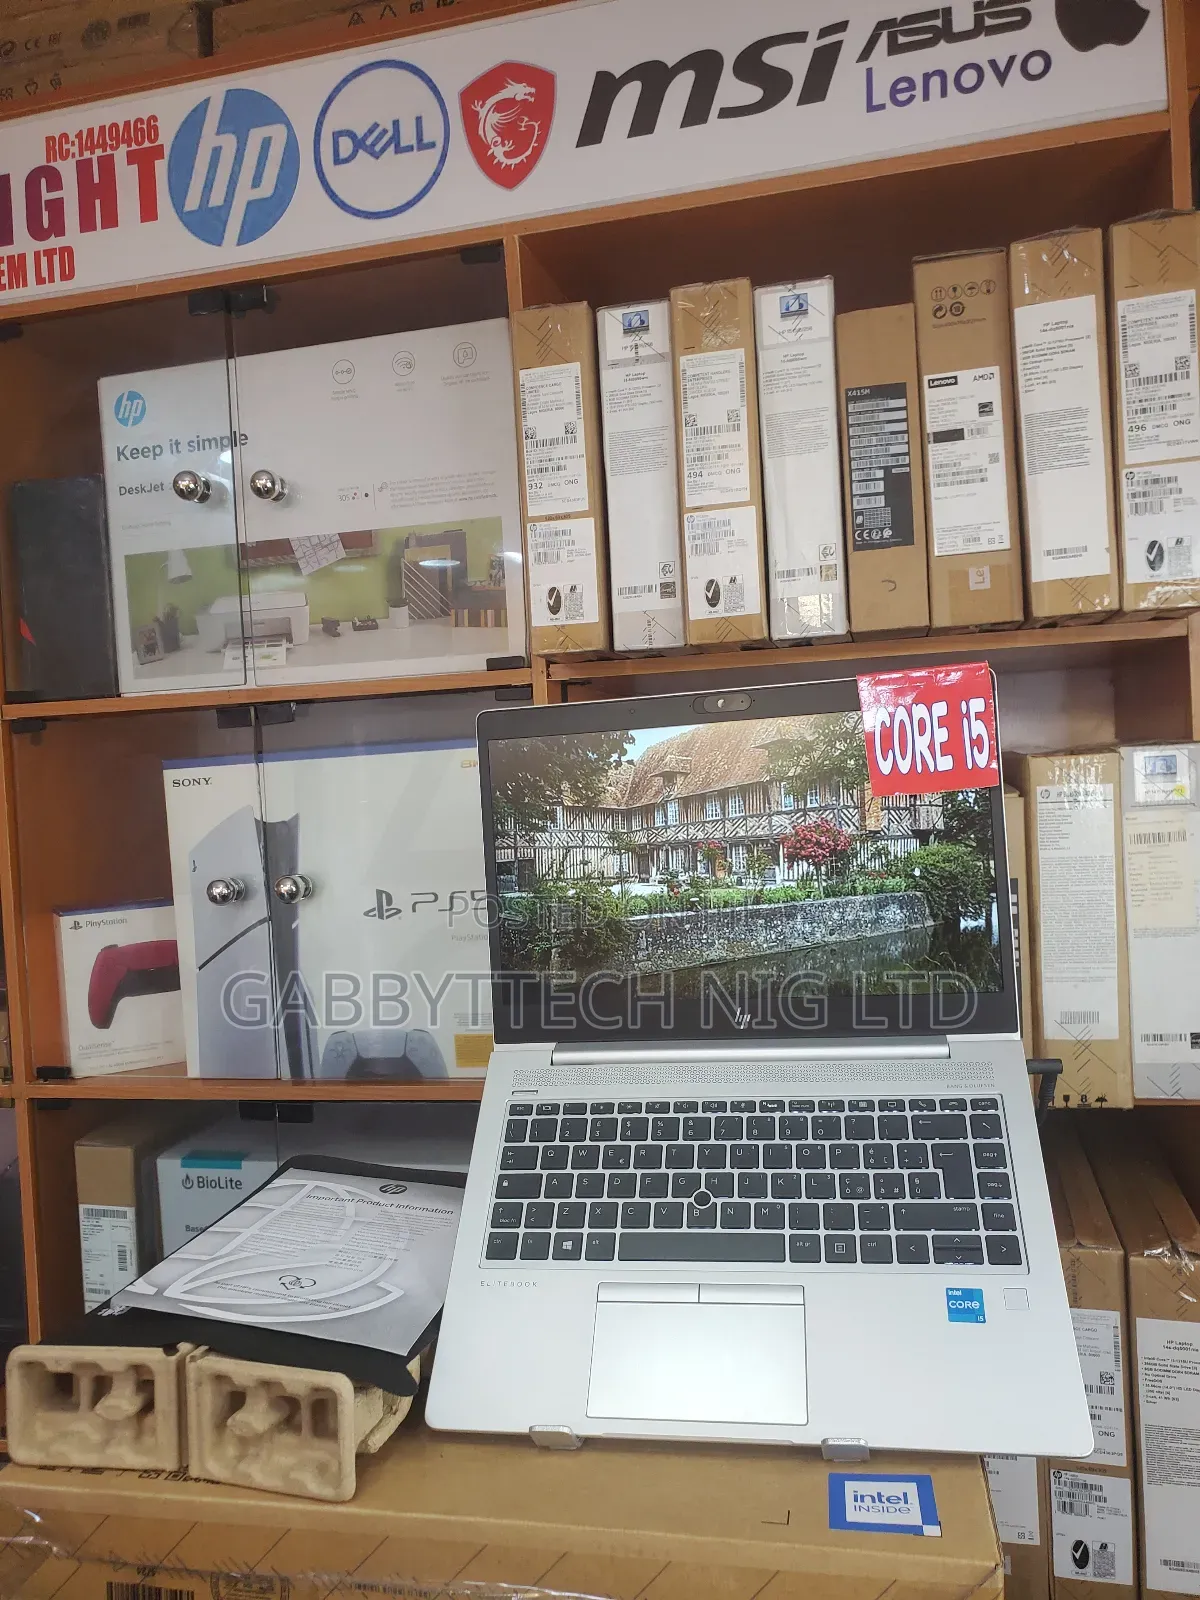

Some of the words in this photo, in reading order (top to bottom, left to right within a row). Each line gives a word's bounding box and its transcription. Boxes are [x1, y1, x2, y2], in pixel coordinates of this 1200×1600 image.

[856, 0, 1032, 64] ASUS
[575, 19, 850, 149] msi
[866, 48, 1053, 113] Lenovo
[45, 114, 160, 164] RC:1449466
[332, 115, 437, 167] DELL
[182, 89, 289, 247] hp
[33, 245, 76, 287] LTD
[929, 377, 956, 387] Lenovo
[973, 374, 989, 382] AMD
[847, 388, 871, 397] X415M
[113, 389, 147, 428] hp
[1127, 423, 1147, 433] 496
[1172, 419, 1192, 427] ONG
[116, 444, 164, 462] Keep
[169, 438, 182, 455] it
[187, 430, 249, 457] simple
[687, 470, 704, 479] 494
[725, 467, 741, 475] ONG
[118, 481, 165, 497] DeskJet
[528, 482, 544, 490] 932
[564, 478, 579, 486] ONG
[873, 700, 954, 776] CORE
[960, 697, 991, 770] i5
[172, 776, 212, 788] SONY
[411, 889, 486, 914] PS5
[450, 933, 490, 943] PlayStatio
[196, 1175, 243, 1190] BioLite
[306, 1193, 354, 1203] Important
[356, 1198, 394, 1209] Product
[396, 1203, 454, 1215] Information
[480, 1280, 538, 1288] ELITEBOOK
[1098, 1430, 1116, 1438] ONG
[853, 1489, 909, 1505] intel
